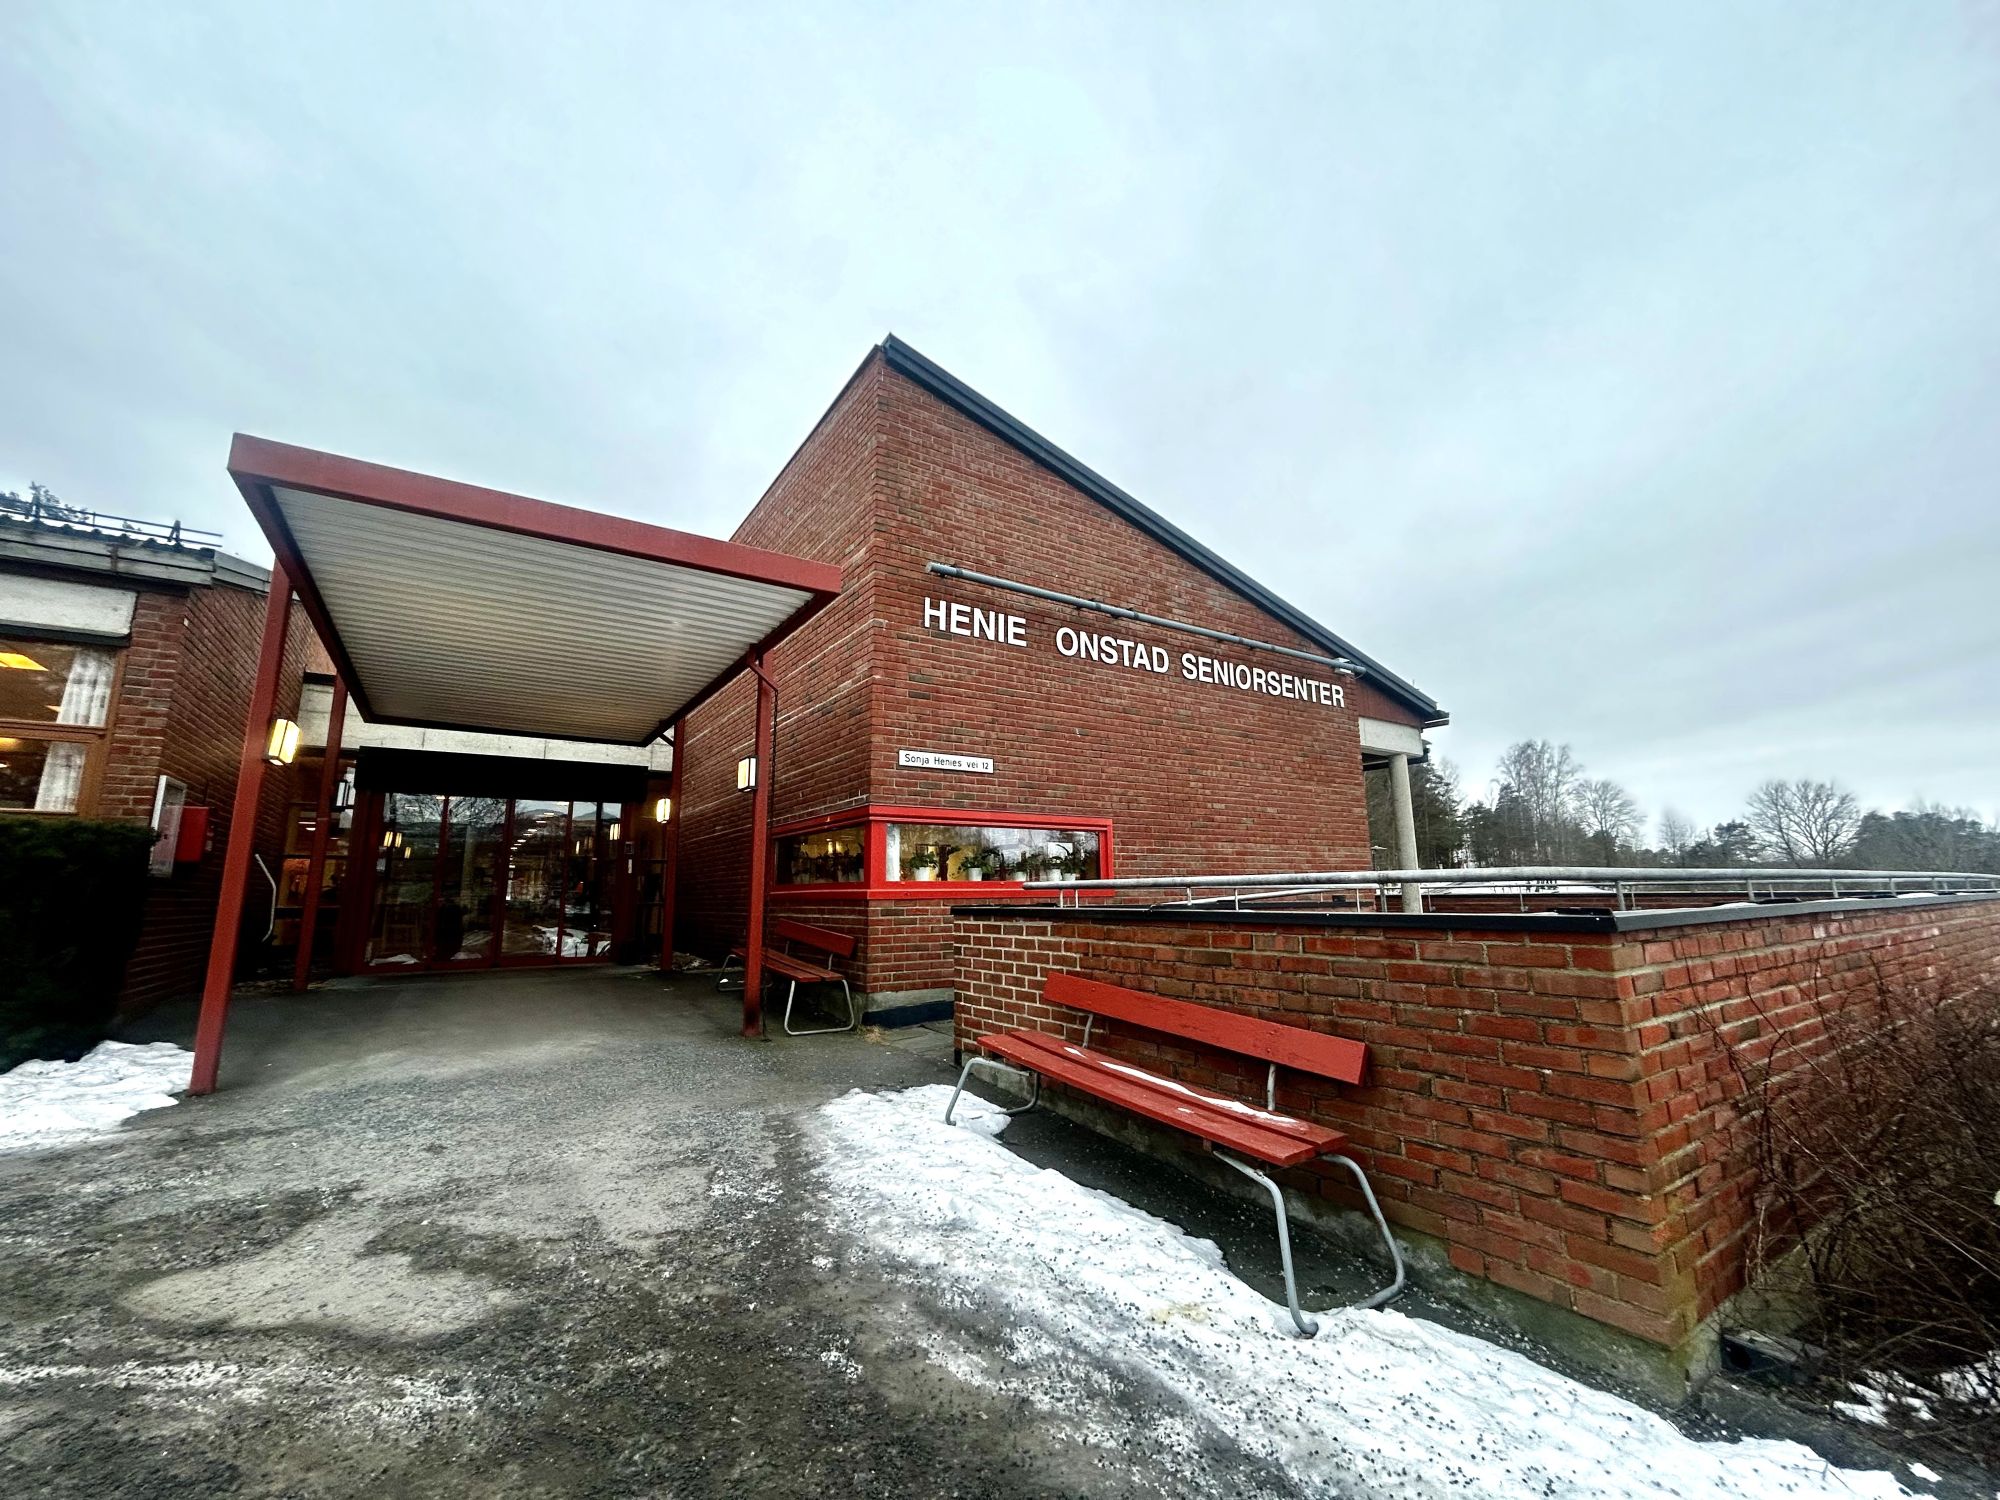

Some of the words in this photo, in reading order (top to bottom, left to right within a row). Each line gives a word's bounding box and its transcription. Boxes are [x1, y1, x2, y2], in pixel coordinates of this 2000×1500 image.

[924, 596, 1027, 647] HENIE
[1055, 626, 1170, 674] ONSTAD
[1181, 652, 1345, 708] SENIORSENTER
[904, 753, 930, 766] Sonja
[934, 756, 962, 767] Henies
[966, 761, 979, 769] vei
[982, 762, 989, 770] 12
